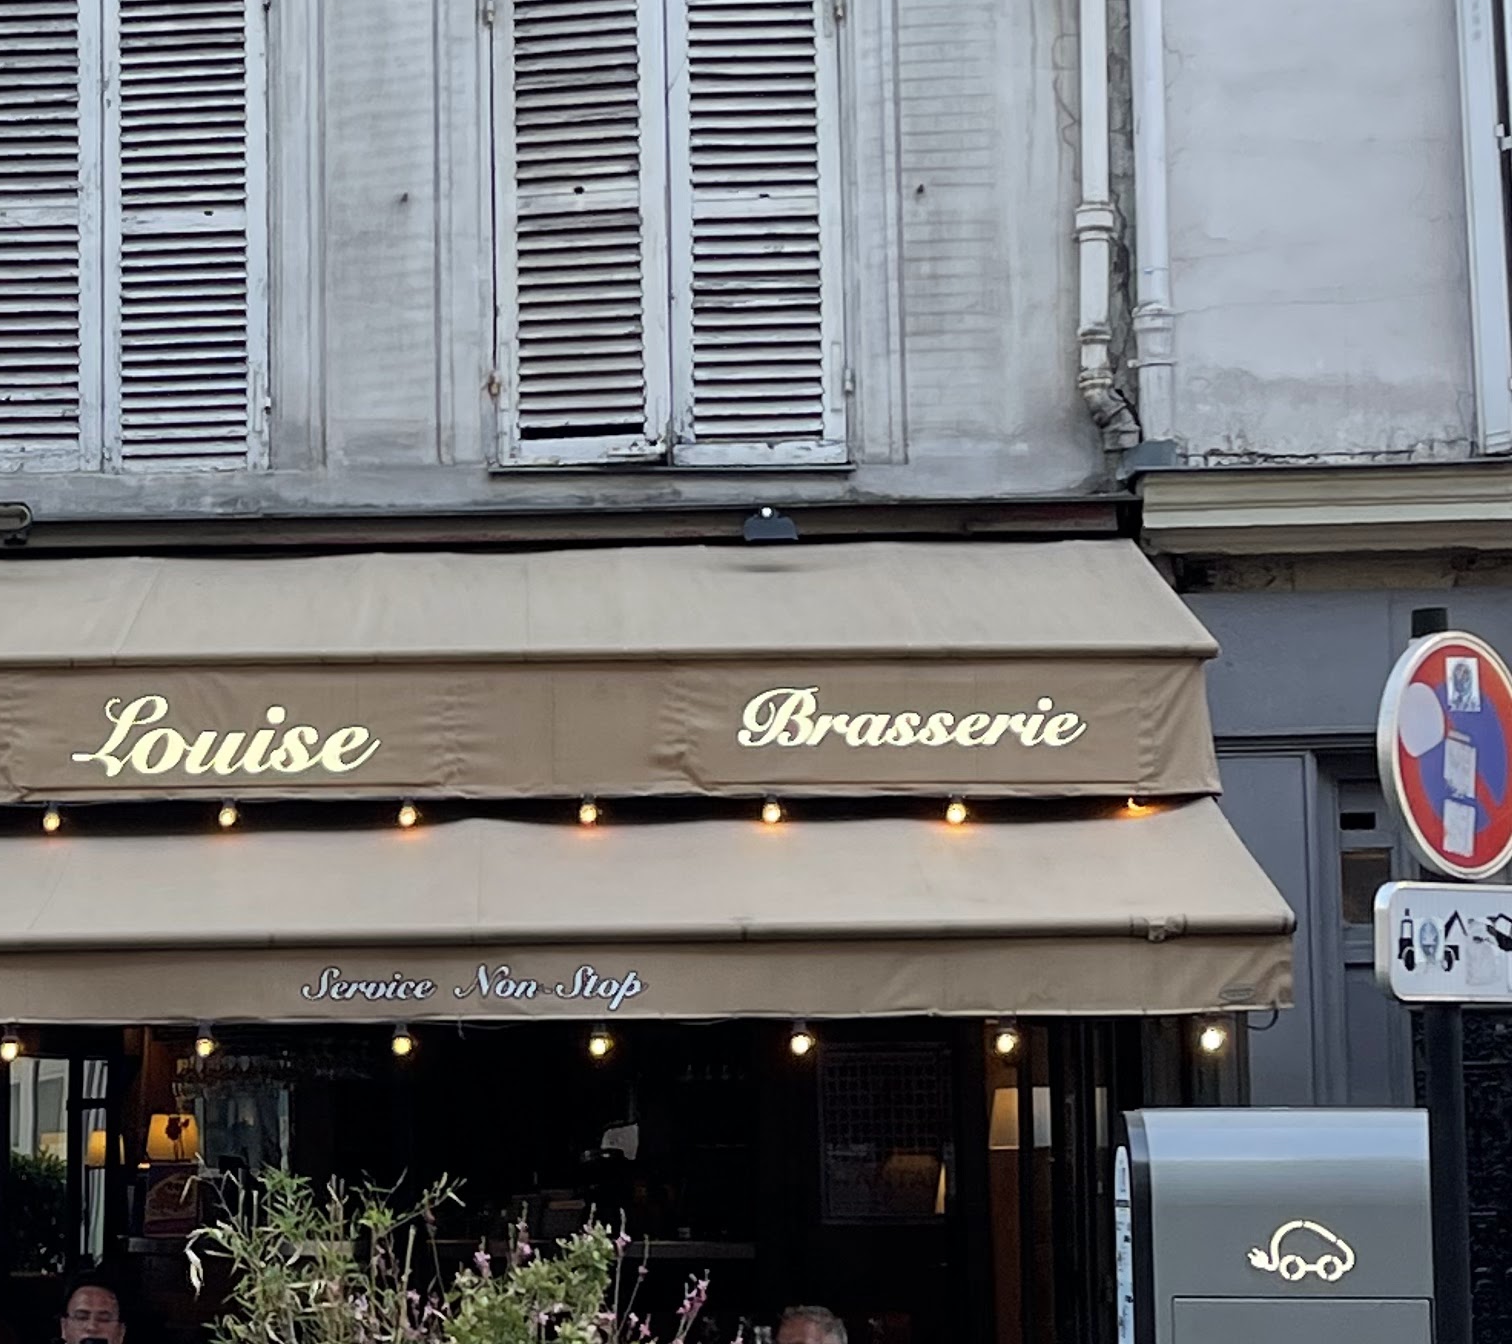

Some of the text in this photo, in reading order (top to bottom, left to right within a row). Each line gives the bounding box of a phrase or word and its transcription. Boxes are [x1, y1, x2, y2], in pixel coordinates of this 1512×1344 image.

[71, 694, 382, 777] Louise
[737, 686, 1088, 747] Brasserie
[301, 966, 440, 1001] Service
